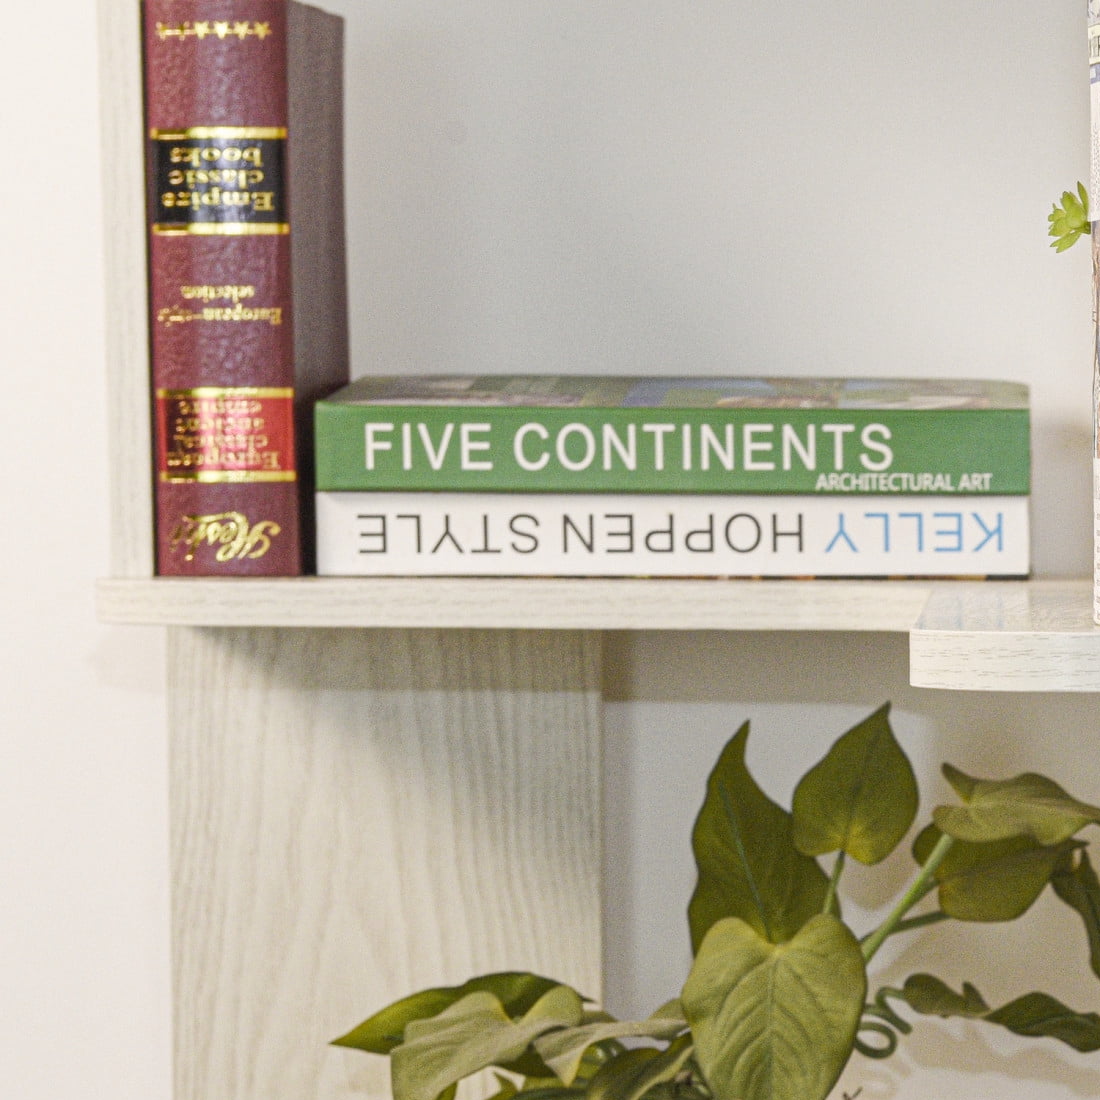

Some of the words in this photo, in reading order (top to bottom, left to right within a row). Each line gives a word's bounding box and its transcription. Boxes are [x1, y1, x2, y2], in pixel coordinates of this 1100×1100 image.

[170, 147, 263, 167] books
[168, 169, 264, 189] classic
[161, 187, 275, 211] Empire
[364, 422, 493, 471] FIVE
[513, 422, 893, 471] CONTINENTS
[815, 473, 955, 491] ARCHITECTURAL
[958, 473, 993, 490] ART
[356, 514, 541, 554] STYLE
[562, 513, 803, 553] HOPPEN
[825, 512, 1003, 553] KELLY
